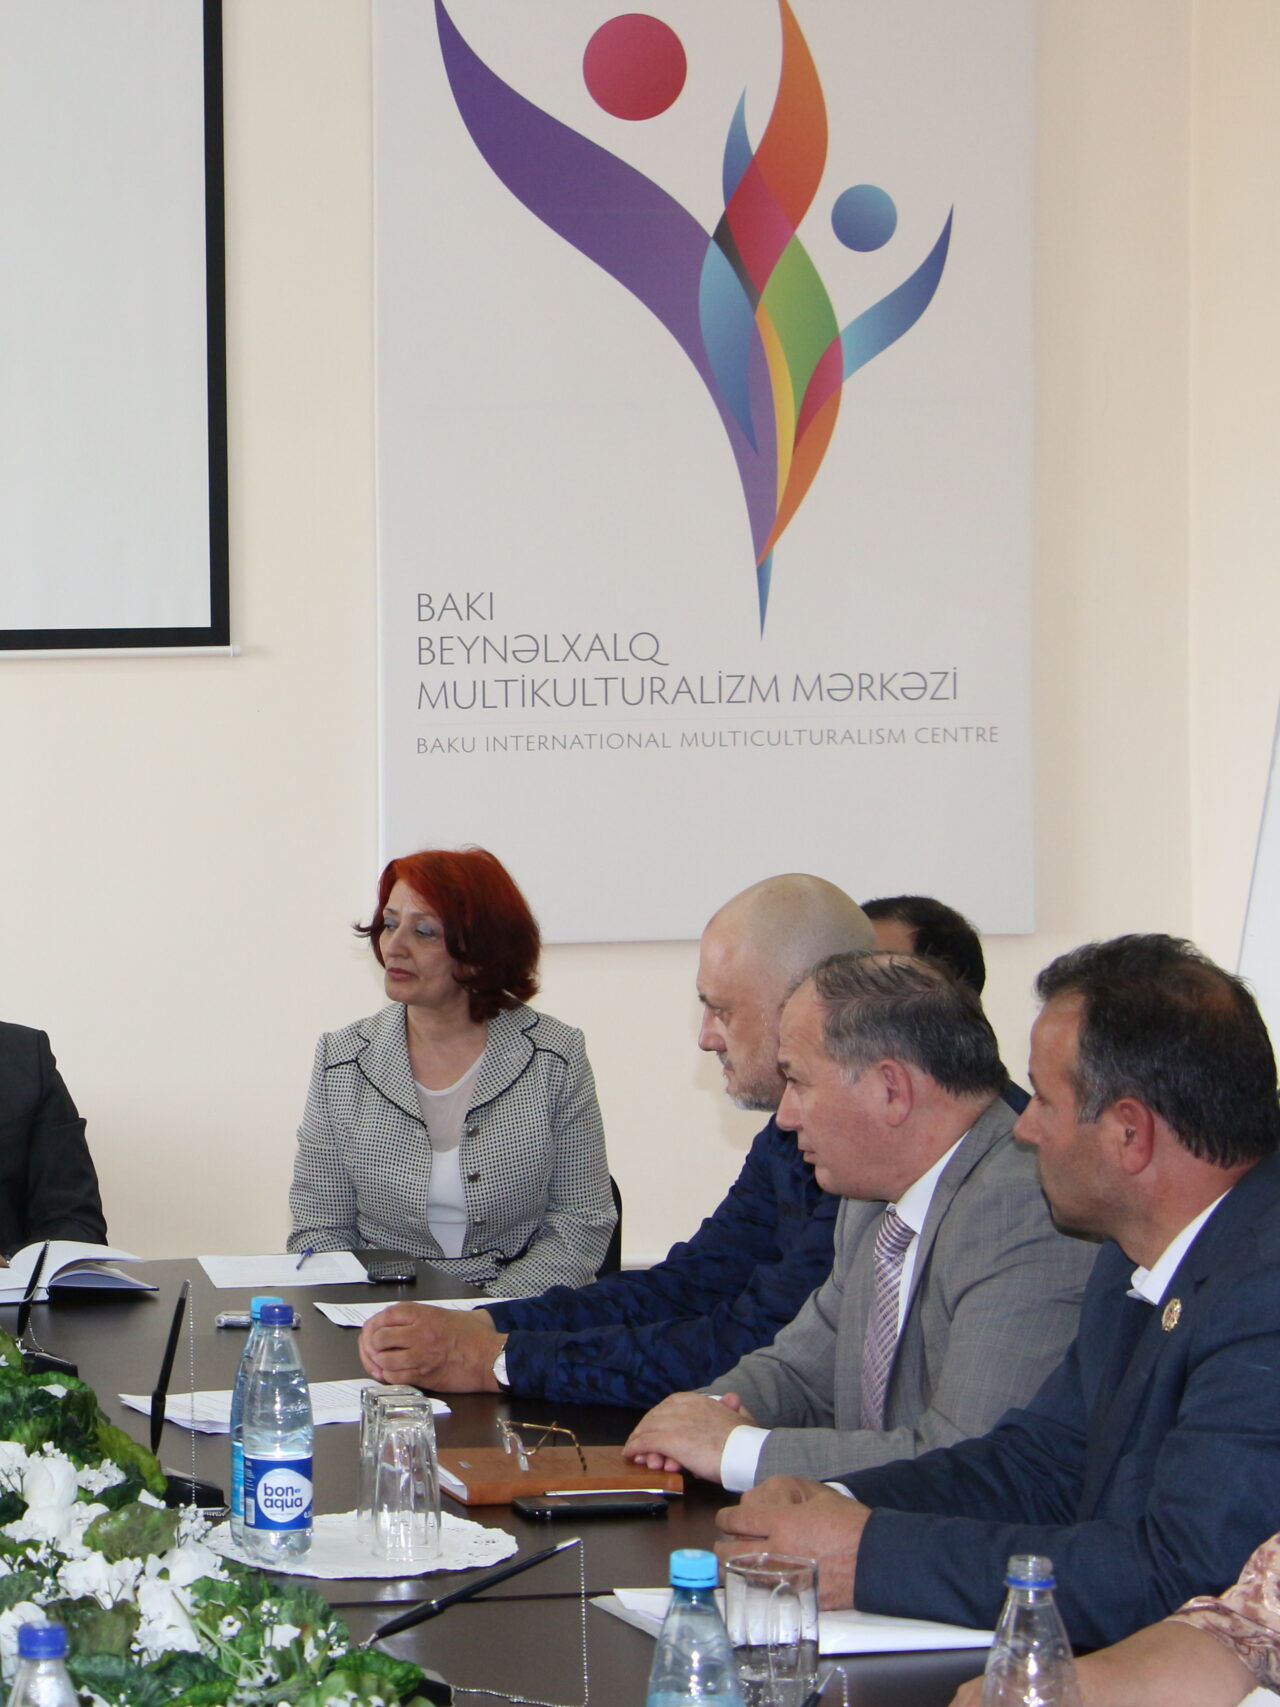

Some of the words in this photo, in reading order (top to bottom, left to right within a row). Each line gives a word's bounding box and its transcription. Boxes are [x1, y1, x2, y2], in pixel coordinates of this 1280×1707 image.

[417, 591, 494, 622] BAKI
[417, 632, 670, 666] BEYNƏLXALQ
[417, 670, 780, 710] MULTİKULTURALİZM
[792, 667, 958, 702] MƏRKƏZİ
[416, 736, 476, 755] BAKU
[485, 731, 672, 753] INTERNATIONAL
[680, 727, 906, 748] MULTICULTURALISM
[914, 725, 999, 745] CENTRE
[263, 1497, 302, 1512] aqua
